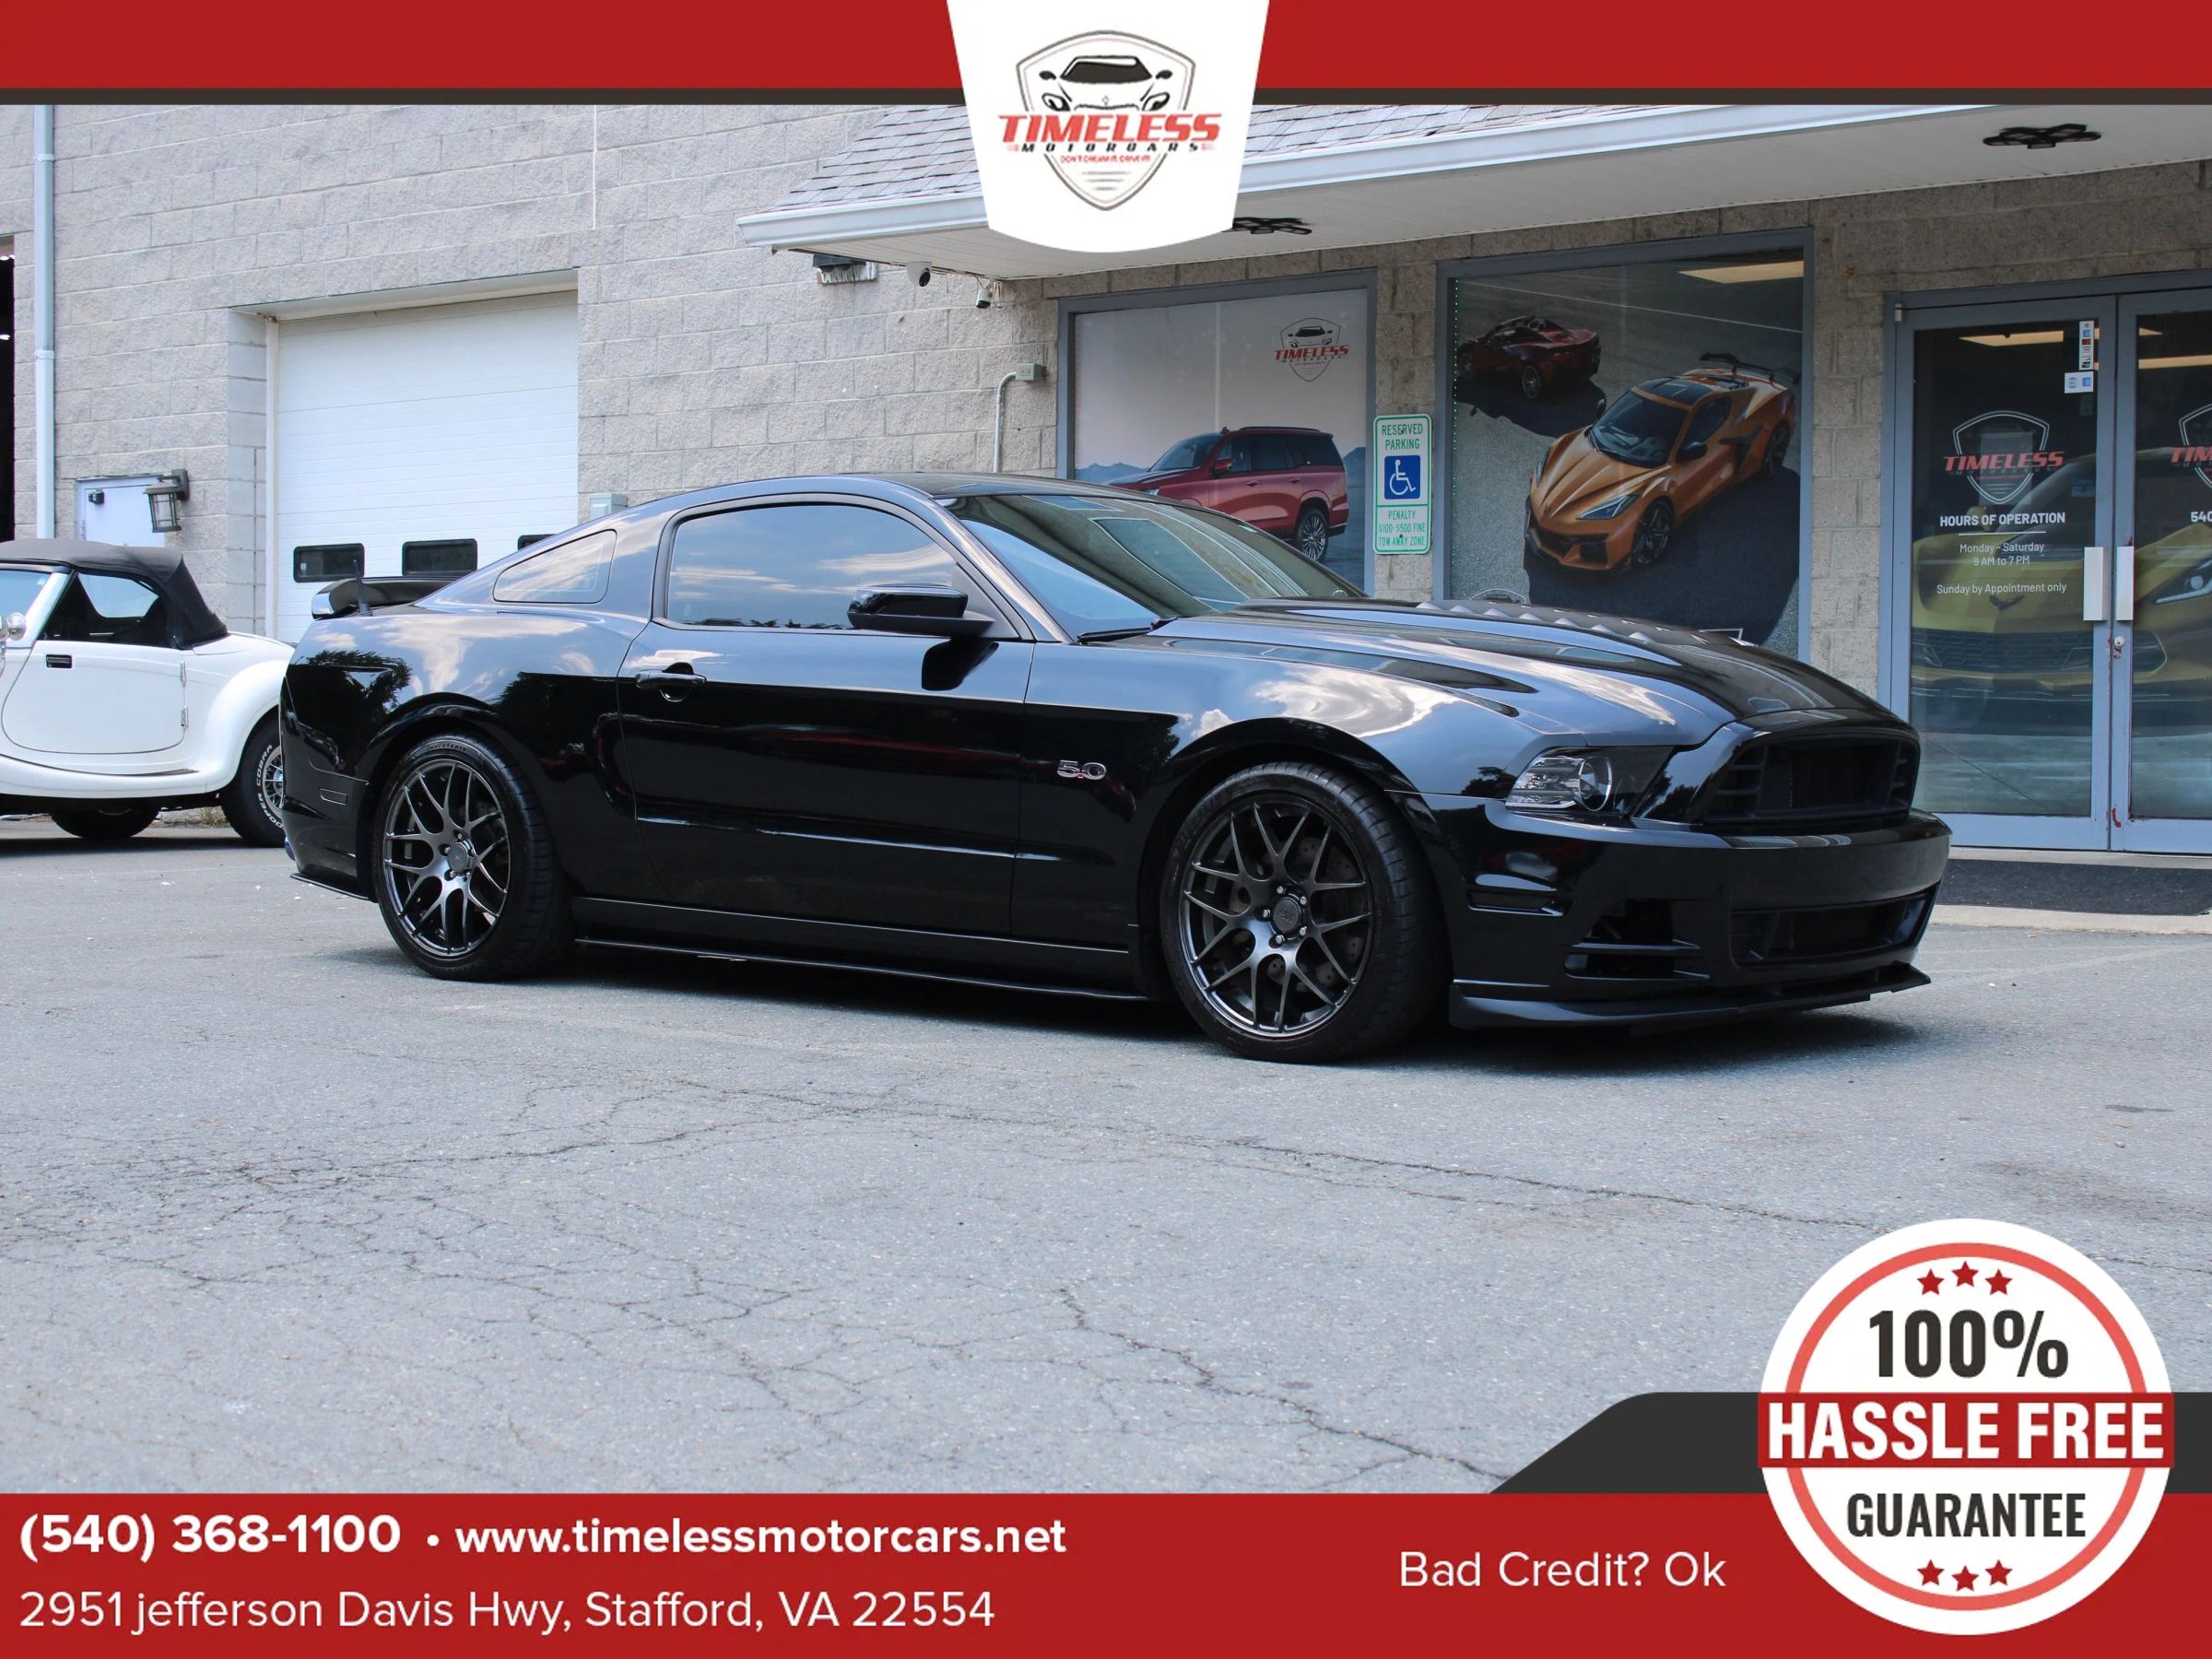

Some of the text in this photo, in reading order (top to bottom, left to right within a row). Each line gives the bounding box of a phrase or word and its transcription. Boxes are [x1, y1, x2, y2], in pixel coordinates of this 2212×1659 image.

[1275, 345, 1349, 360] TIMELESS
[1382, 423, 1423, 436] RESERVED
[1385, 438, 1420, 451] PARKING
[1943, 452, 2065, 471] TIMELESS
[1388, 510, 1417, 521] PENALTY
[1939, 512, 2066, 527] HOURS OF OPERATION
[1413, 522, 1426, 533] FINE
[1379, 535, 1426, 547] TOW AWAY ZONE
[1959, 544, 1994, 555] Monday
[2002, 542, 2044, 553] Saturday
[1972, 556, 2030, 567] 9 AM to 7 PM
[1936, 582, 2067, 595] Sunday by Appointment only
[1056, 759, 1107, 781] 5.0
[256, 744, 284, 829] OOPER COBRA
